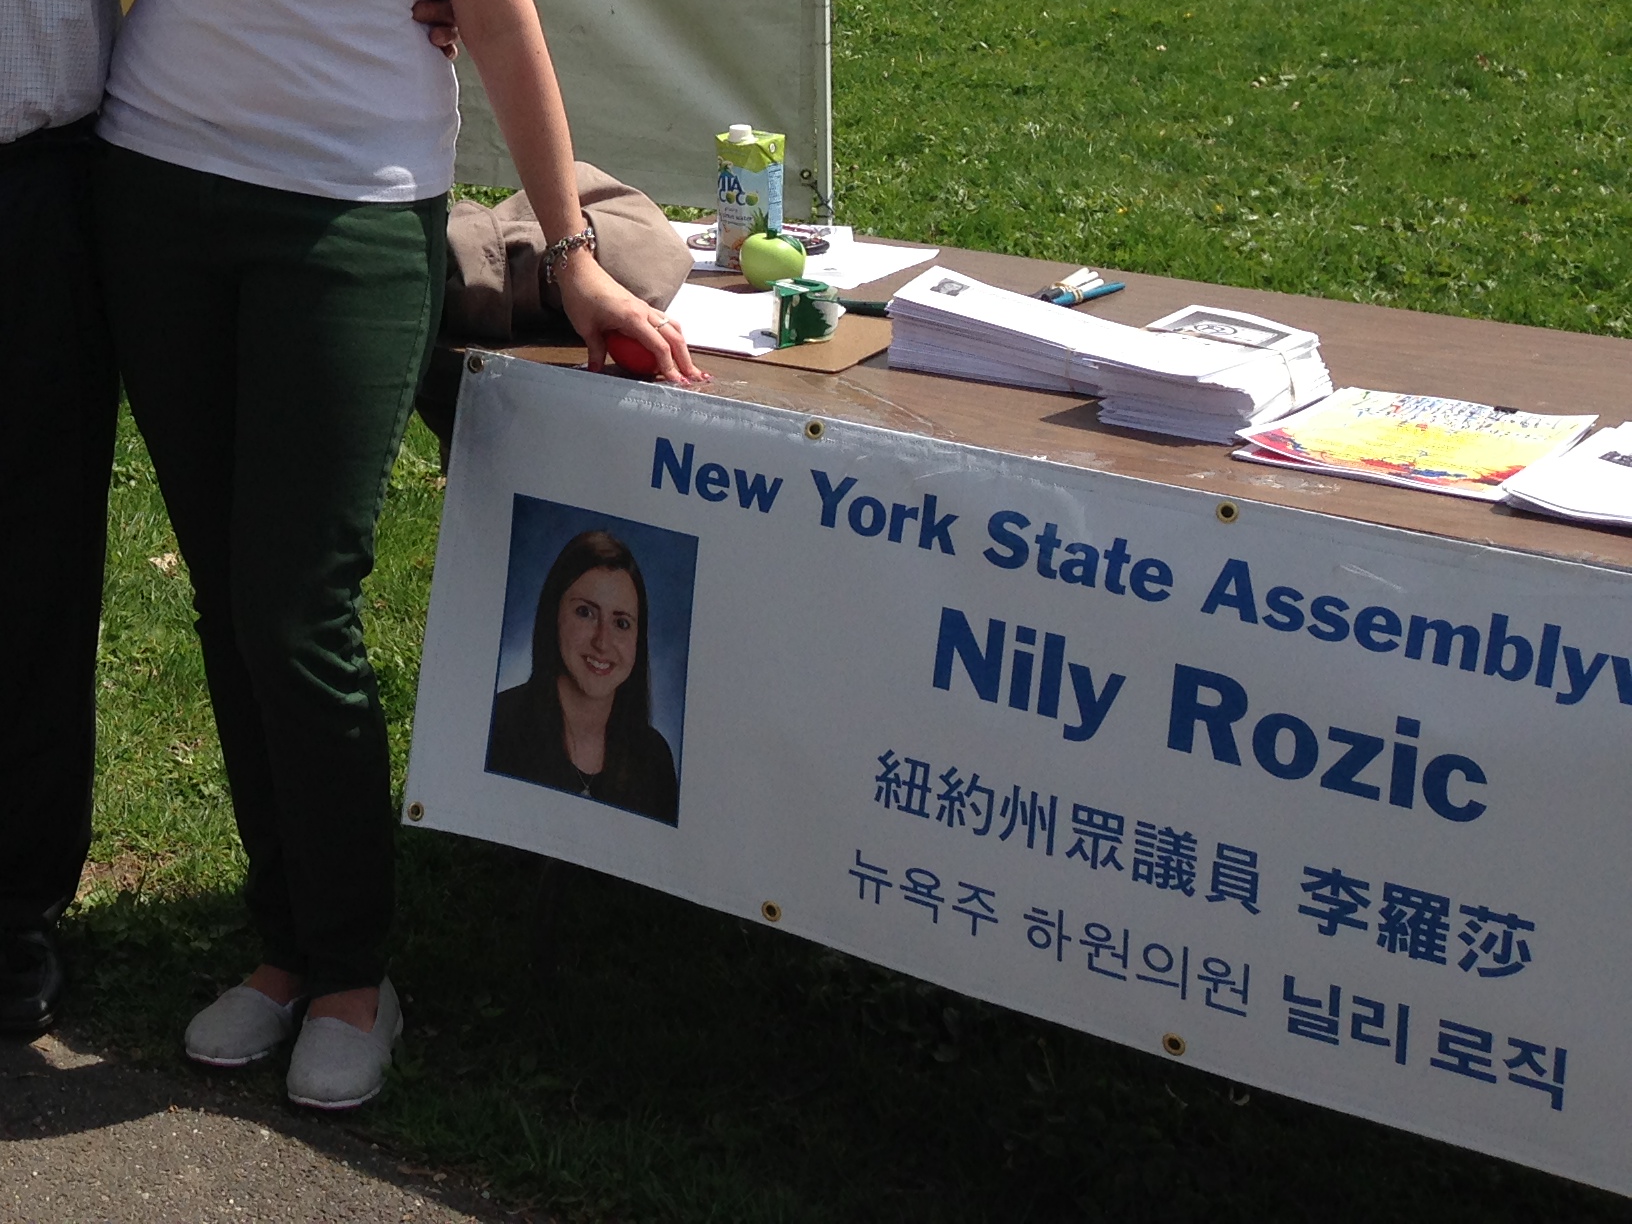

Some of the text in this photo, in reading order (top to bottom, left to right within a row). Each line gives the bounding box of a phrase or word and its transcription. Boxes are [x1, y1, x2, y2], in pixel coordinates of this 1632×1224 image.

[651, 437, 1632, 706] New York State Assembly
[932, 606, 1487, 823] Nily Rozic
[848, 849, 1568, 1112] 뉴욕주 하원의원 닐리 로직
[874, 749, 1535, 978] 紐約州眾議員 李羅莎
